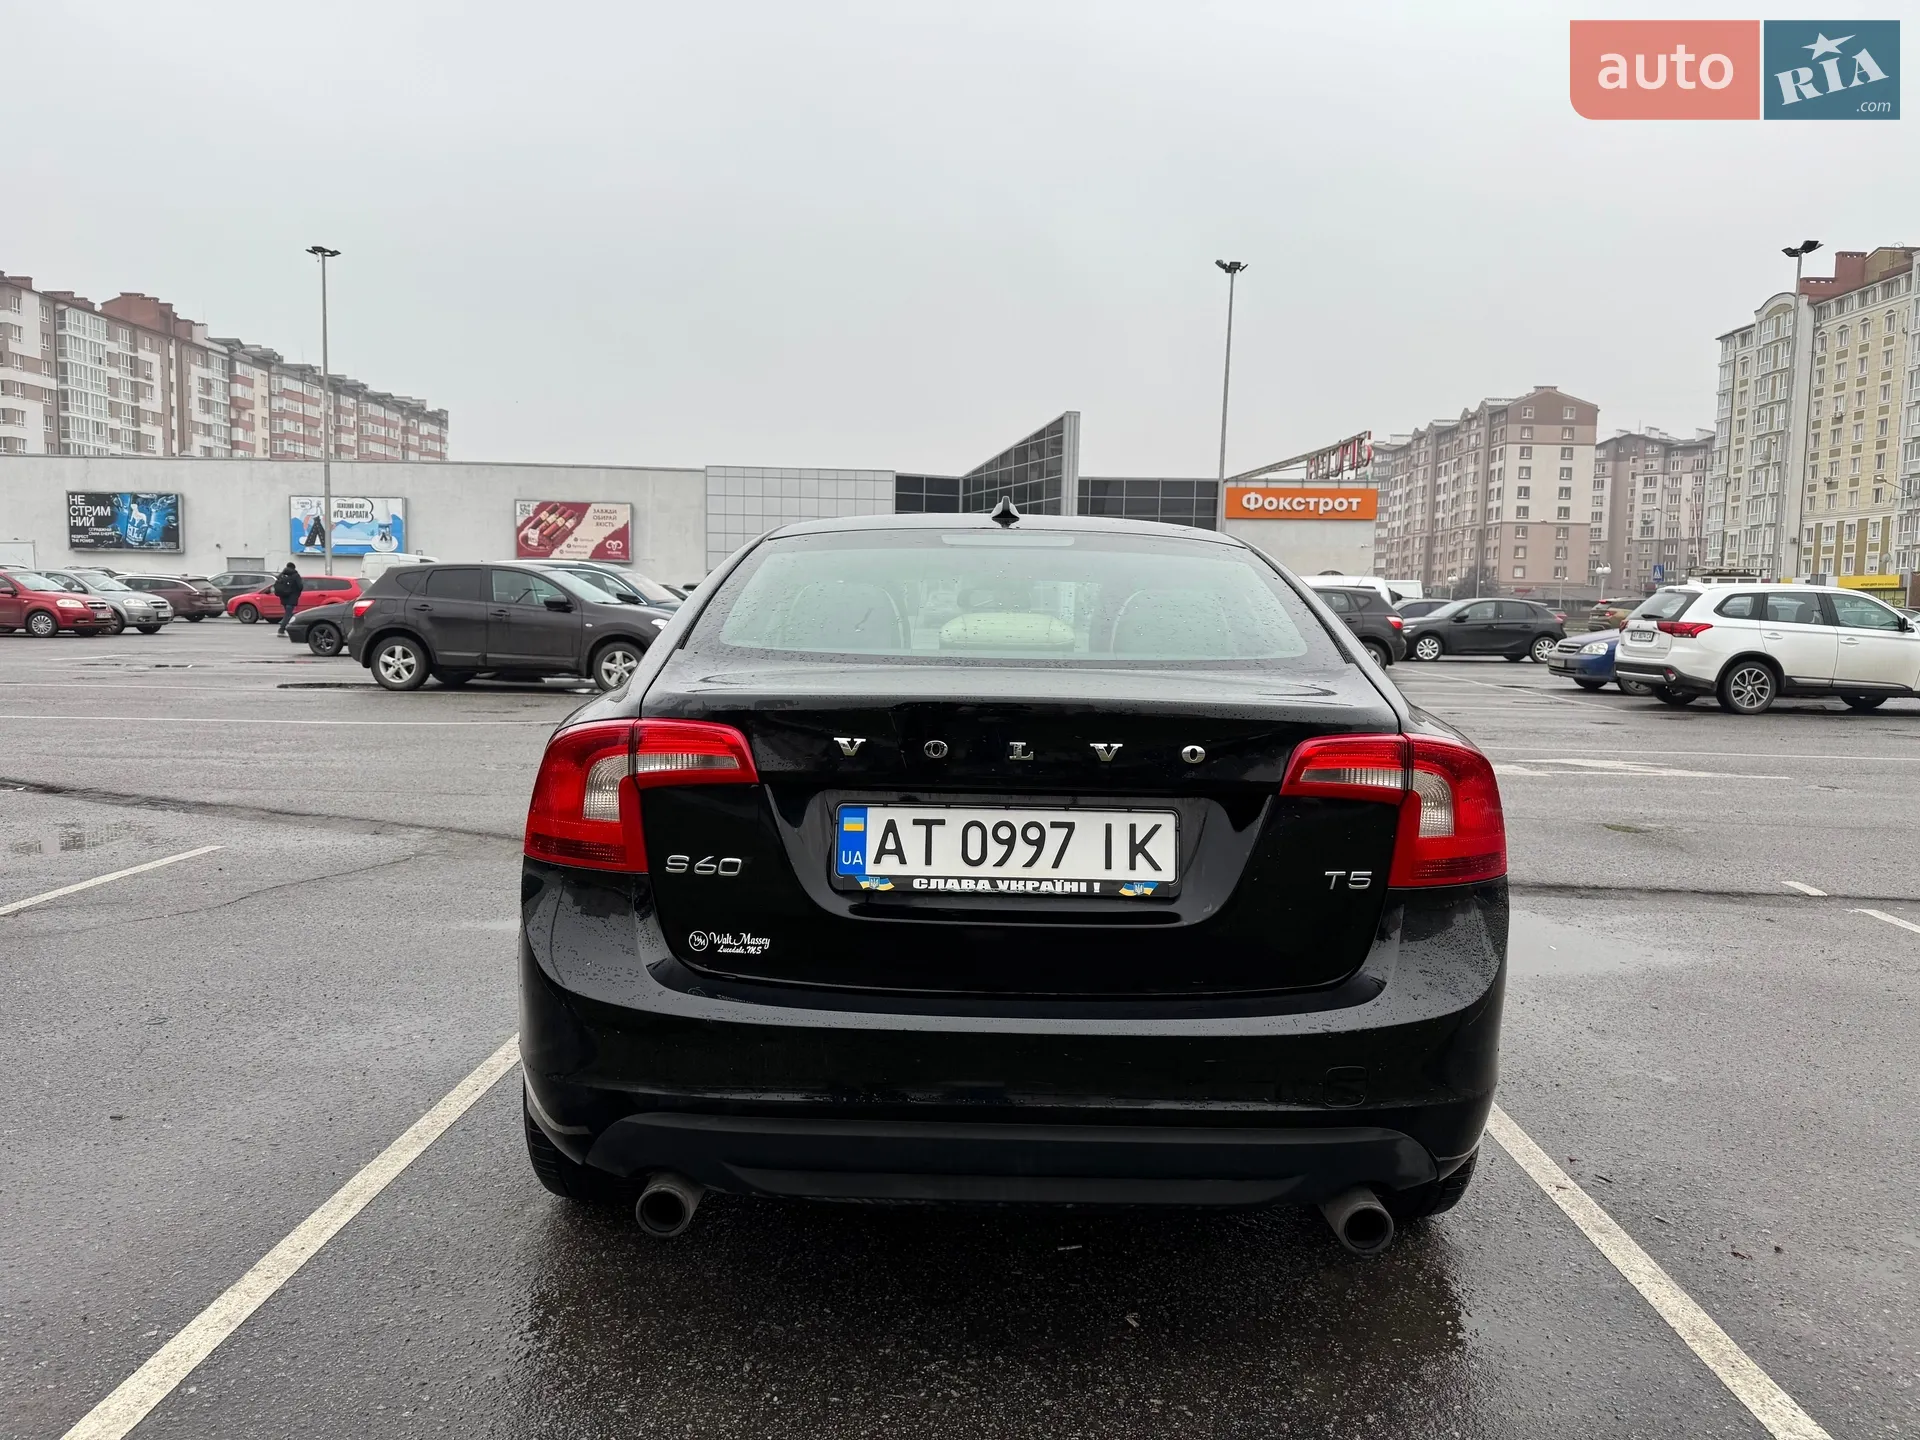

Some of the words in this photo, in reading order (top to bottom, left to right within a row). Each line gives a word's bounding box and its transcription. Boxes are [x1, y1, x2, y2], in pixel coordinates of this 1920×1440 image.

[69, 495, 85, 505] НЕ
[1241, 491, 1362, 515] Фокстрот
[70, 506, 110, 516] СТРИМ
[70, 514, 95, 526] НИЙ
[834, 737, 1206, 764] VOLVO
[842, 850, 863, 866] UA
[873, 818, 946, 866] AT
[961, 820, 1076, 869] 0997
[1104, 822, 1163, 872] IK
[665, 854, 742, 877] S60
[912, 877, 991, 892] СЛАВА
[996, 877, 1087, 894] УКРАЇНІ
[1324, 871, 1372, 890] T5
[708, 931, 734, 946] Walt
[733, 932, 771, 950] Massey
